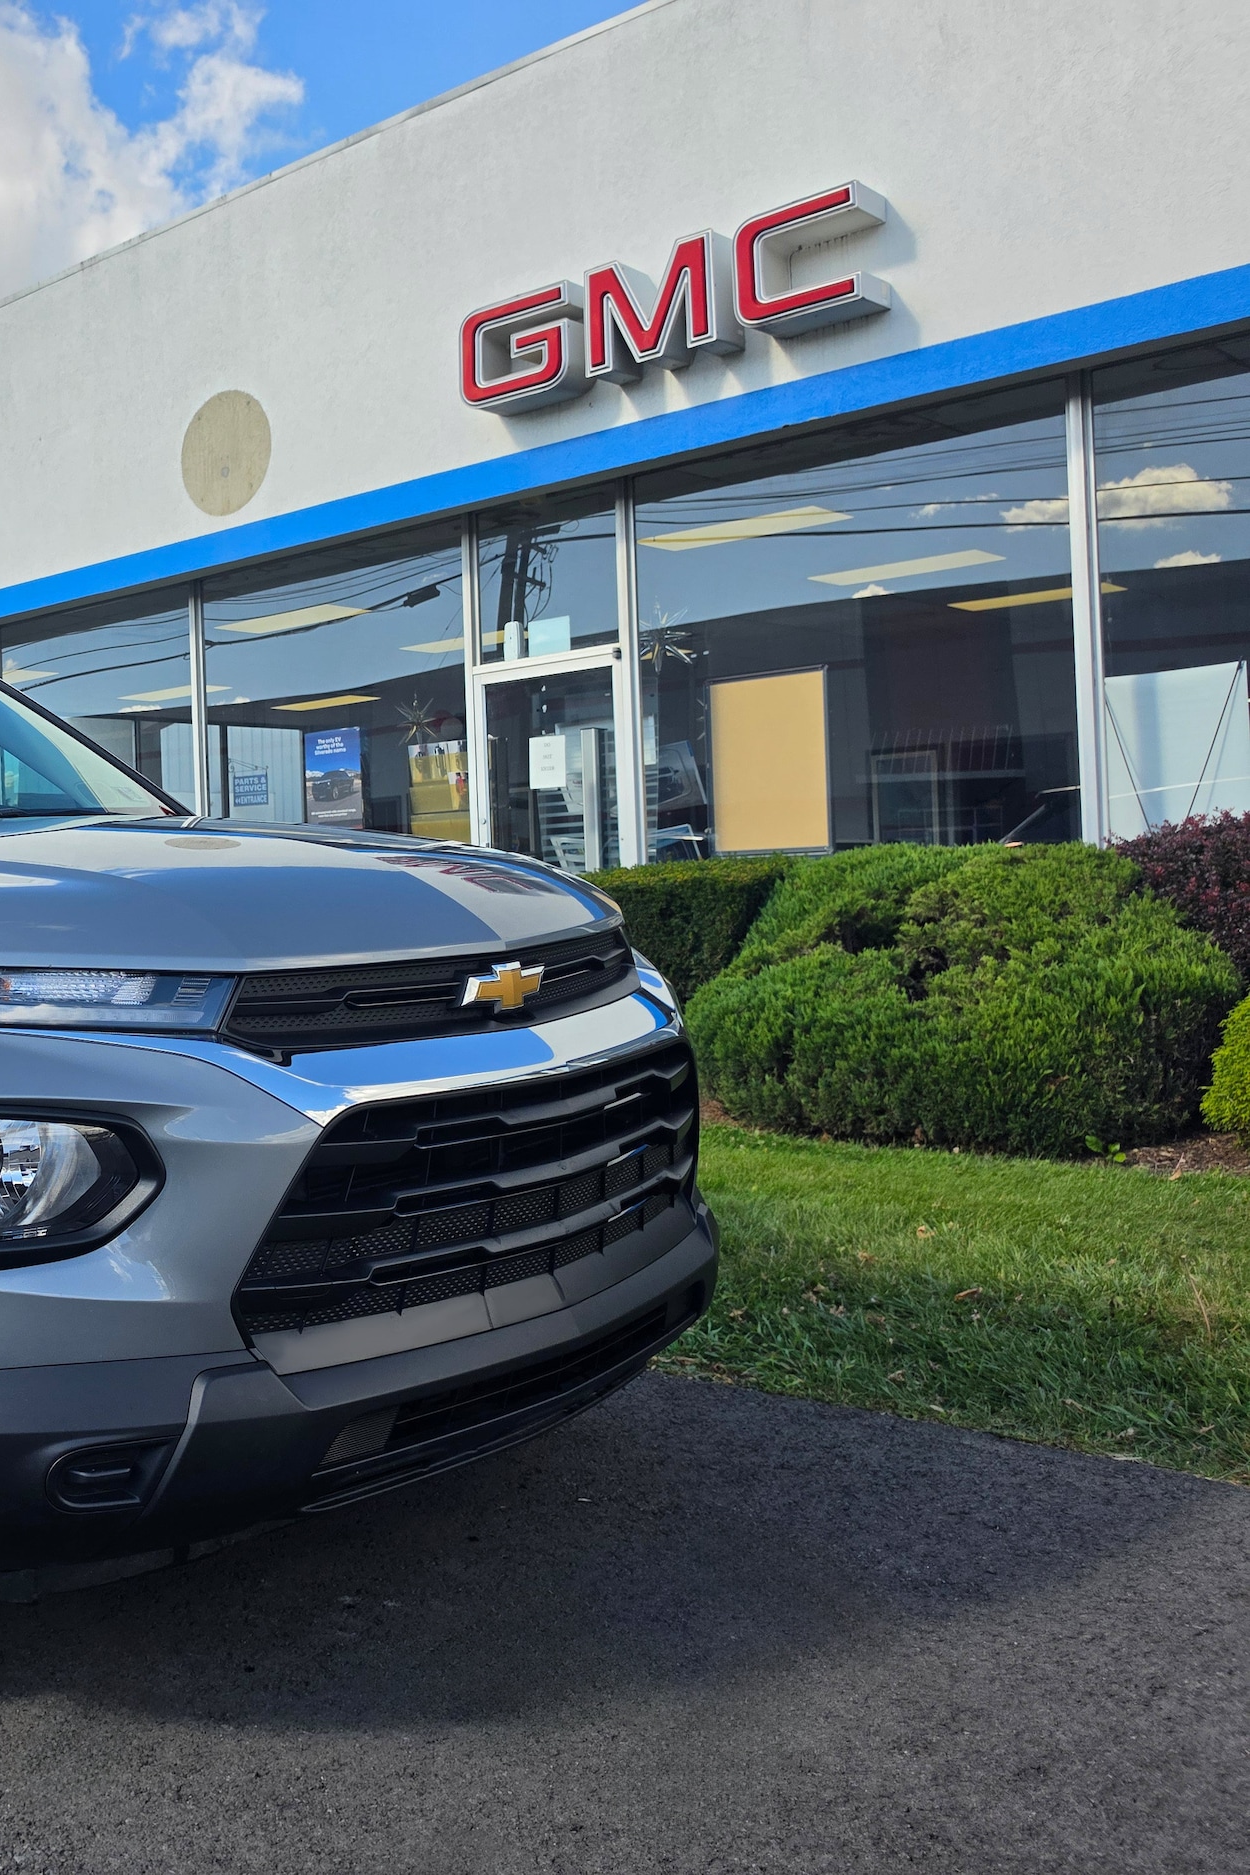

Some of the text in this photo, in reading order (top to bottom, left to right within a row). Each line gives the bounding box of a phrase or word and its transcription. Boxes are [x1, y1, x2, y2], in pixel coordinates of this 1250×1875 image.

[459, 180, 888, 412] GMC
[235, 777, 259, 785] PARTS
[235, 784, 267, 793] SERVICE
